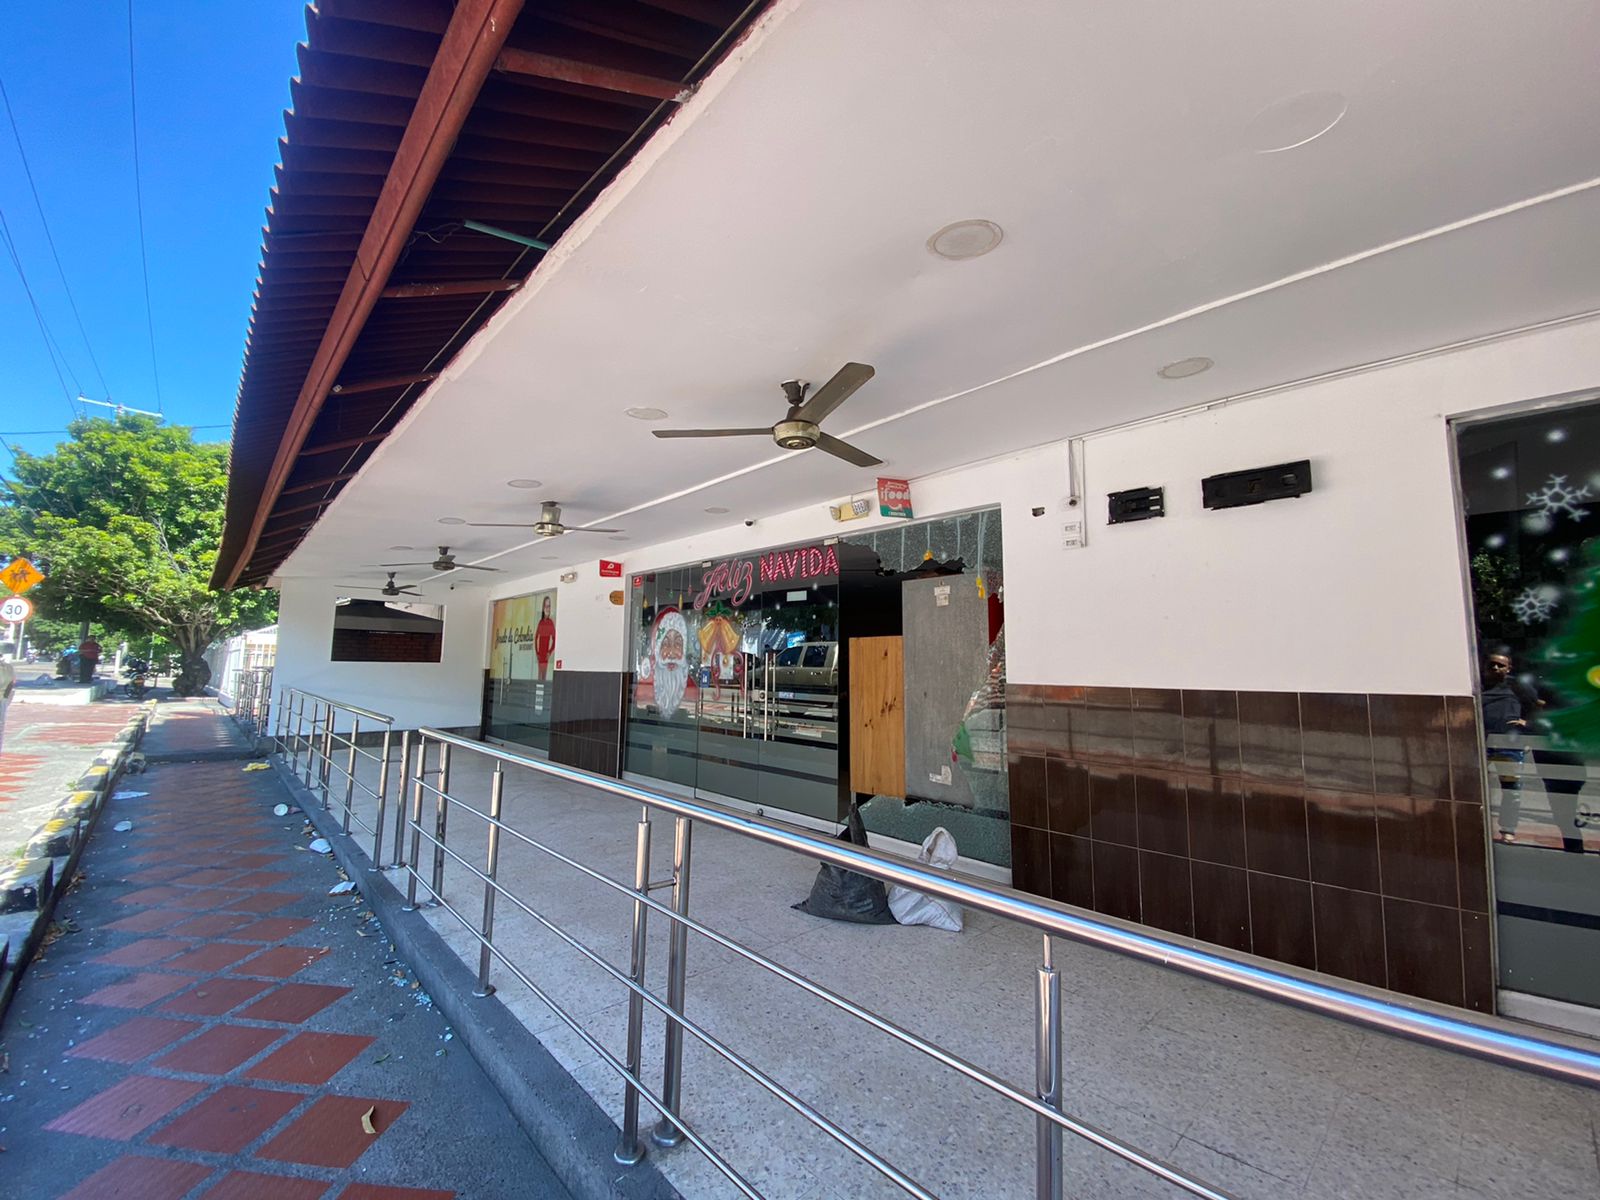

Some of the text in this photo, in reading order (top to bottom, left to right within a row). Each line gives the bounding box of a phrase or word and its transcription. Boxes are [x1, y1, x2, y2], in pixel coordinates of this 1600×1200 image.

[693, 545, 839, 611] Feliz NAVIDA
[5, 604, 22, 615] 30
